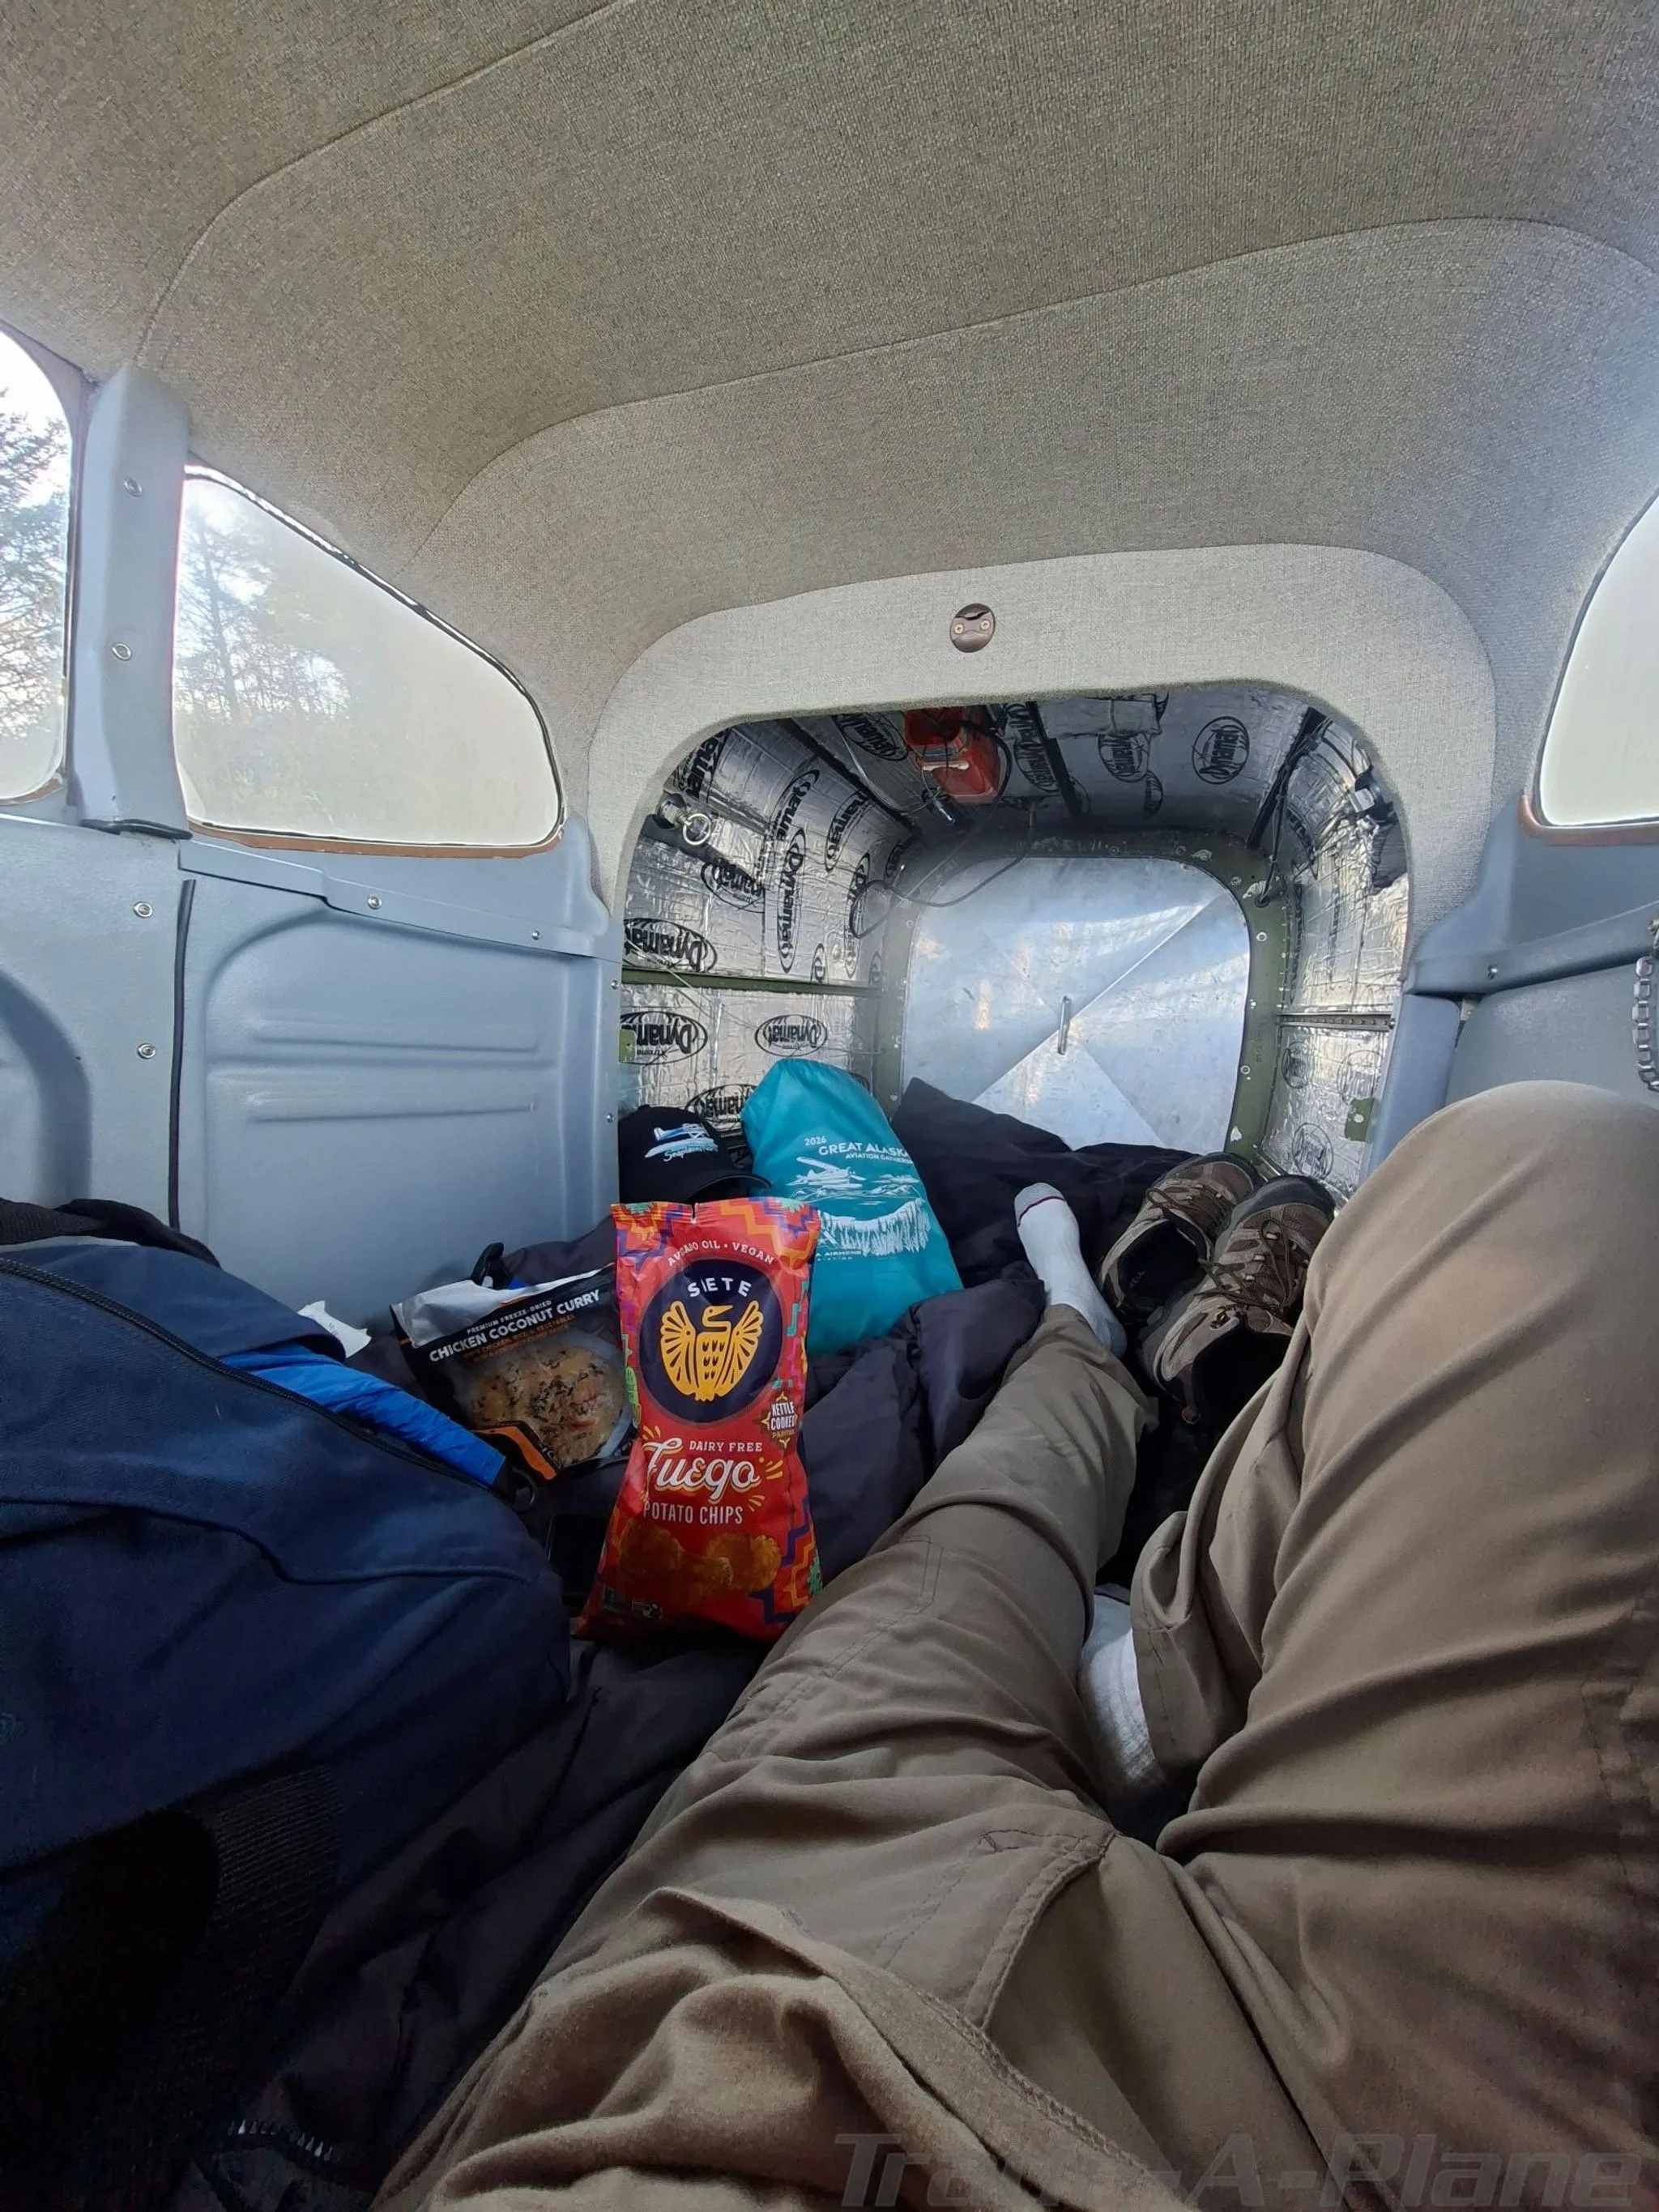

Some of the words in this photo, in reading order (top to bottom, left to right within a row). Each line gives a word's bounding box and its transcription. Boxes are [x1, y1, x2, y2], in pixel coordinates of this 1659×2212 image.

[1099, 732, 1140, 775] ynamat
[1199, 730, 1239, 776] Dynamat
[775, 782, 810, 840] amat
[779, 842, 804, 961] Dynamat
[621, 1018, 693, 1055] Dynam
[767, 1023, 820, 1049] Dynamat
[804, 1136, 827, 1146] 2026
[818, 1142, 863, 1156] GREAT
[866, 1143, 910, 1157] ALASKA
[845, 1152, 880, 1160] AVIATION
[881, 1153, 914, 1165] GATHERIN
[702, 1240, 721, 1249] OIL
[732, 1242, 774, 1265] VEGAN
[687, 1277, 752, 1298] SIETE
[429, 1332, 488, 1363] CHICKEN
[488, 1307, 553, 1340] COCONUT
[557, 1289, 600, 1315] CURRY
[466, 1319, 499, 1335] PREMIUM
[500, 1300, 552, 1323] FREEZE-DRIED
[771, 1402, 795, 1417] KETTLE
[689, 1440, 725, 1452] DAIRY
[729, 1442, 763, 1452] FREE
[642, 1437, 761, 1505] Fuego
[643, 1502, 693, 1524] POTATO
[699, 1506, 744, 1524] CHIPS
